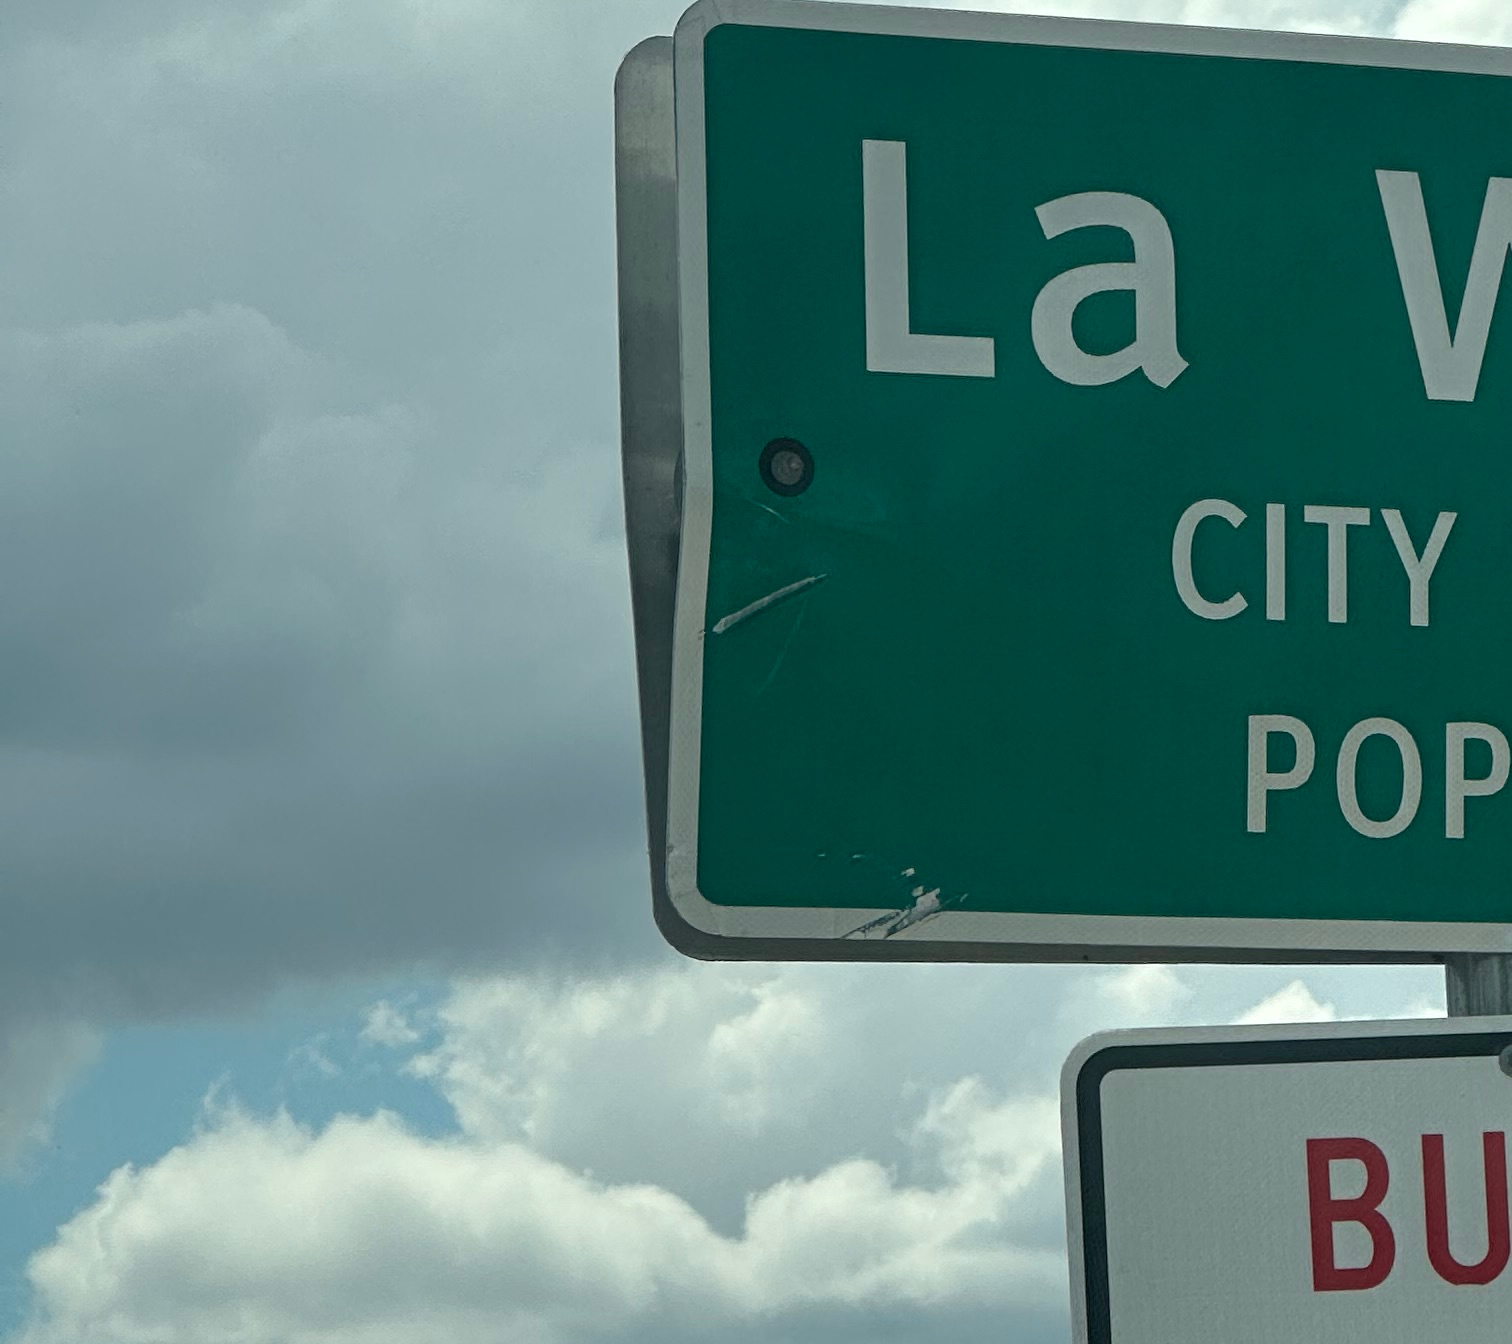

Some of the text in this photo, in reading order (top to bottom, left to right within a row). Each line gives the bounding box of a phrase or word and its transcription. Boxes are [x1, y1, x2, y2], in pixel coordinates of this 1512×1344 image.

[861, 138, 1191, 390] La
[1171, 497, 1459, 628] CITY
[1245, 713, 1512, 840] POP
